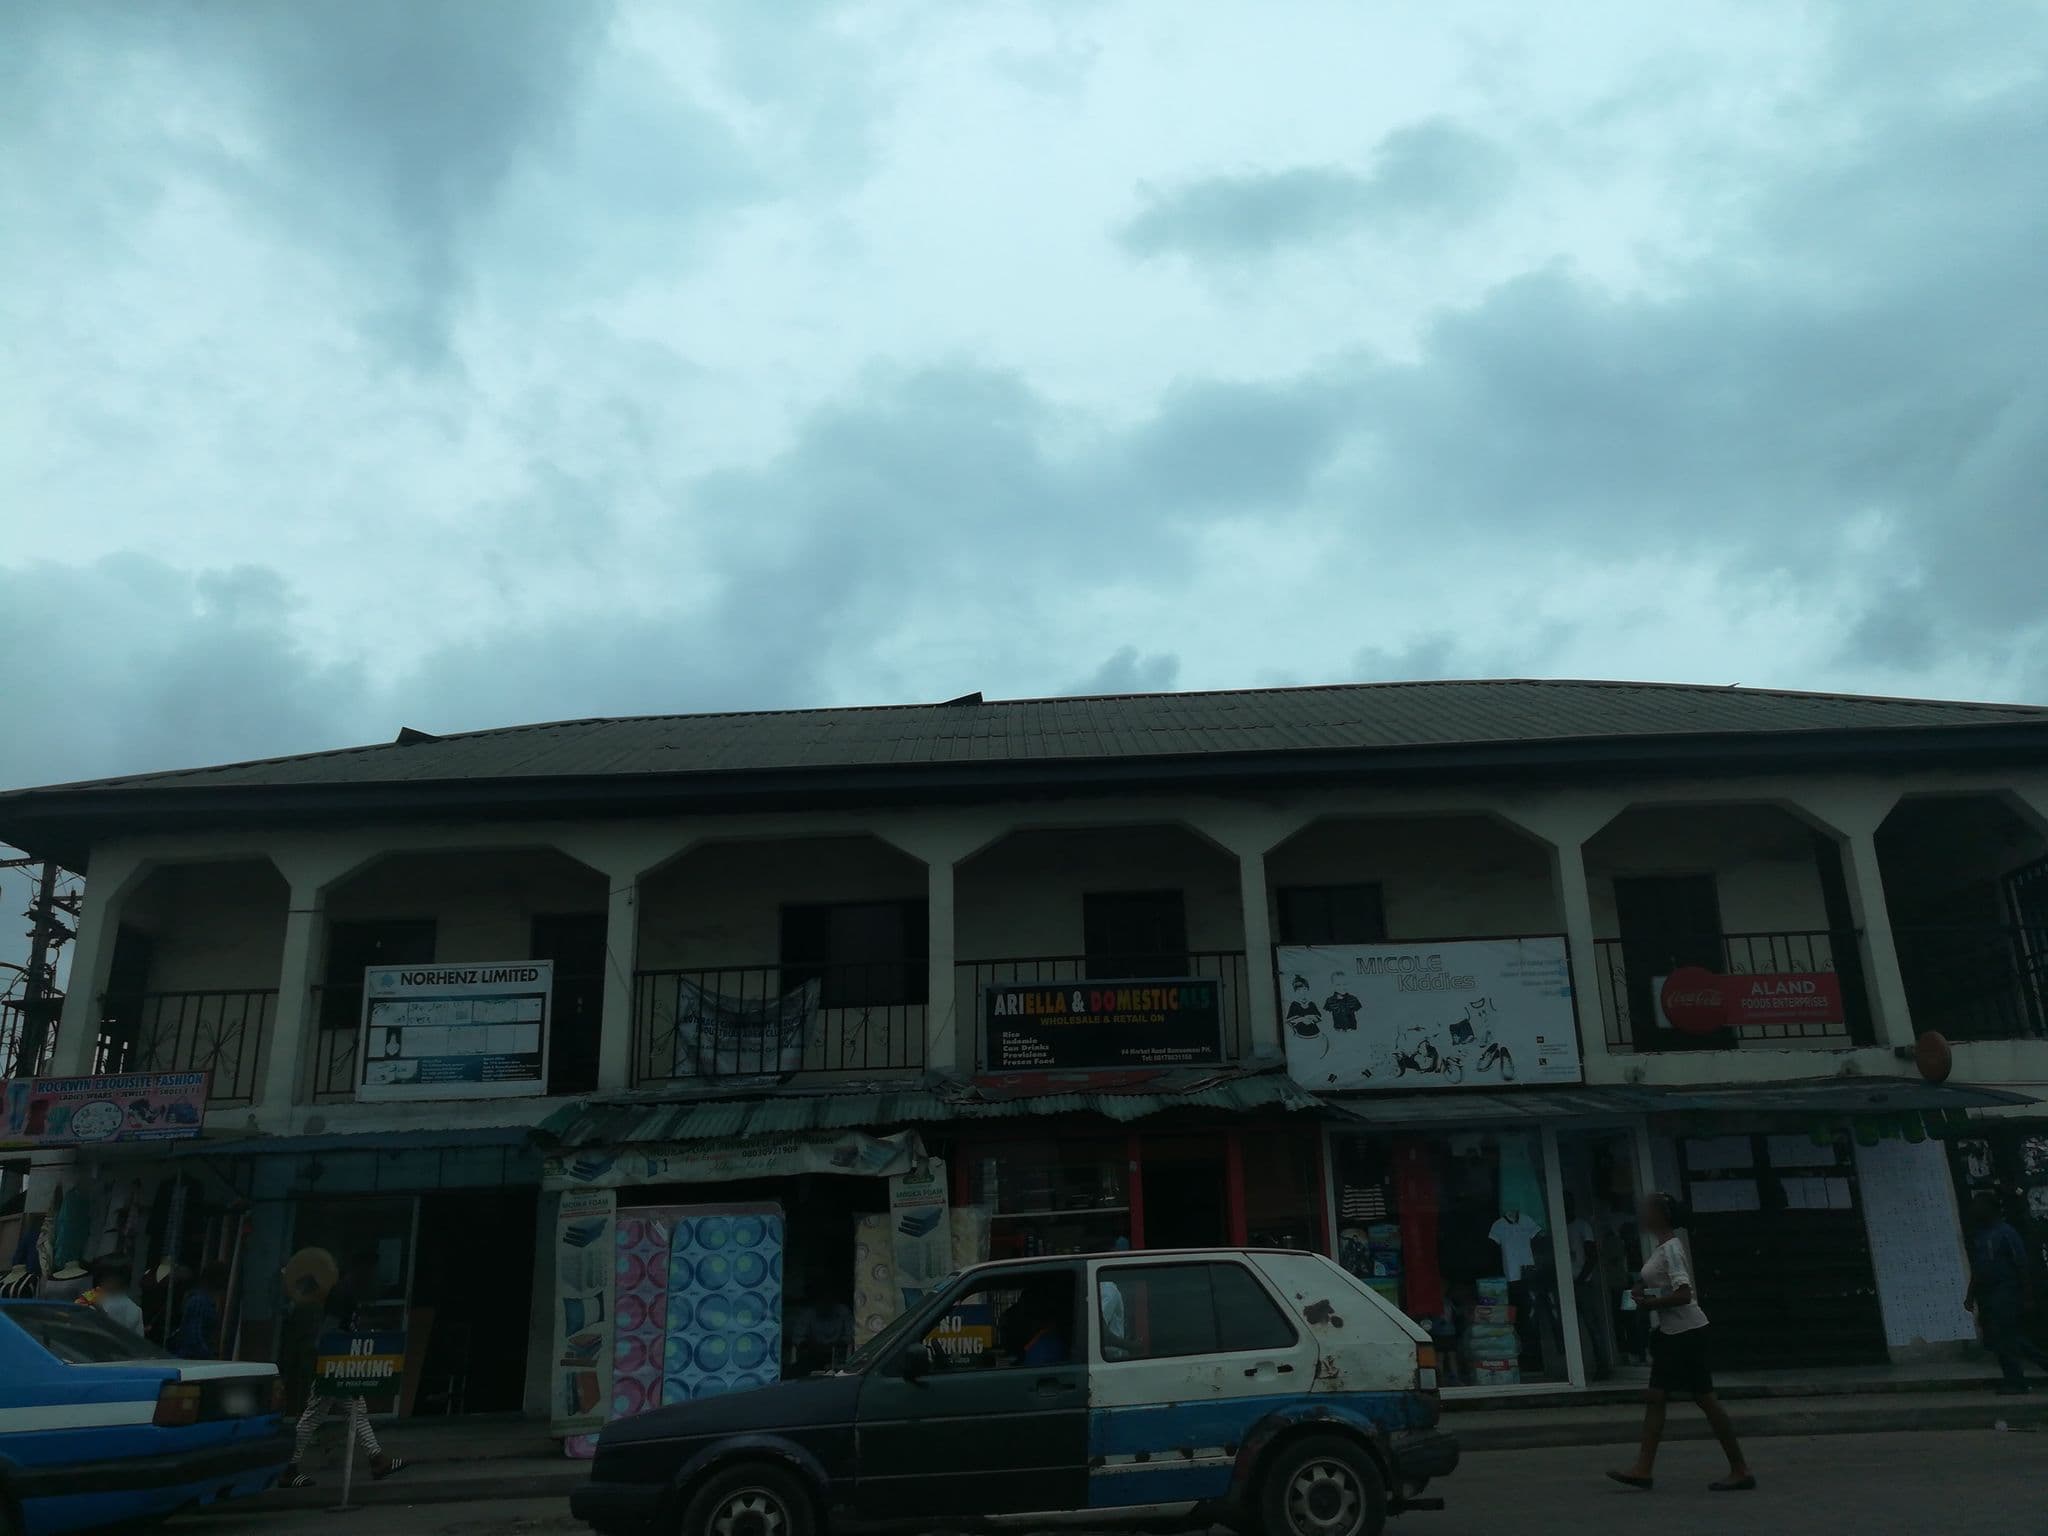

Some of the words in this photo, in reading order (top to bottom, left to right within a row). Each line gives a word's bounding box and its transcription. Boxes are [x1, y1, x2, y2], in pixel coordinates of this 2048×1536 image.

[1356, 954, 1442, 975] MICOLE
[401, 970, 477, 986] NORHENZ
[482, 968, 538, 984] LIMITED
[1398, 972, 1476, 992] Kiddies
[1751, 980, 1817, 996] ALAND
[994, 991, 1066, 1016] ARIELLA
[1072, 990, 1087, 1013] &
[1741, 997, 1773, 1009] FOODS
[1774, 996, 1829, 1009] ENTERPRISES
[1040, 1015, 1100, 1025] WHOLESALE
[1103, 1015, 1110, 1024] &
[1113, 1014, 1149, 1024] RETAIL
[1002, 1031, 1021, 1040] Rice
[1022, 1042, 1050, 1051] Drinks
[1003, 1052, 1047, 1060] Provisions
[1003, 1059, 1032, 1067] Frozen
[1034, 1057, 1056, 1066] Food
[156, 1074, 204, 1087] FASHION
[940, 1315, 962, 1333] NO
[350, 1338, 375, 1357] NO
[324, 1360, 394, 1379] PARKING
